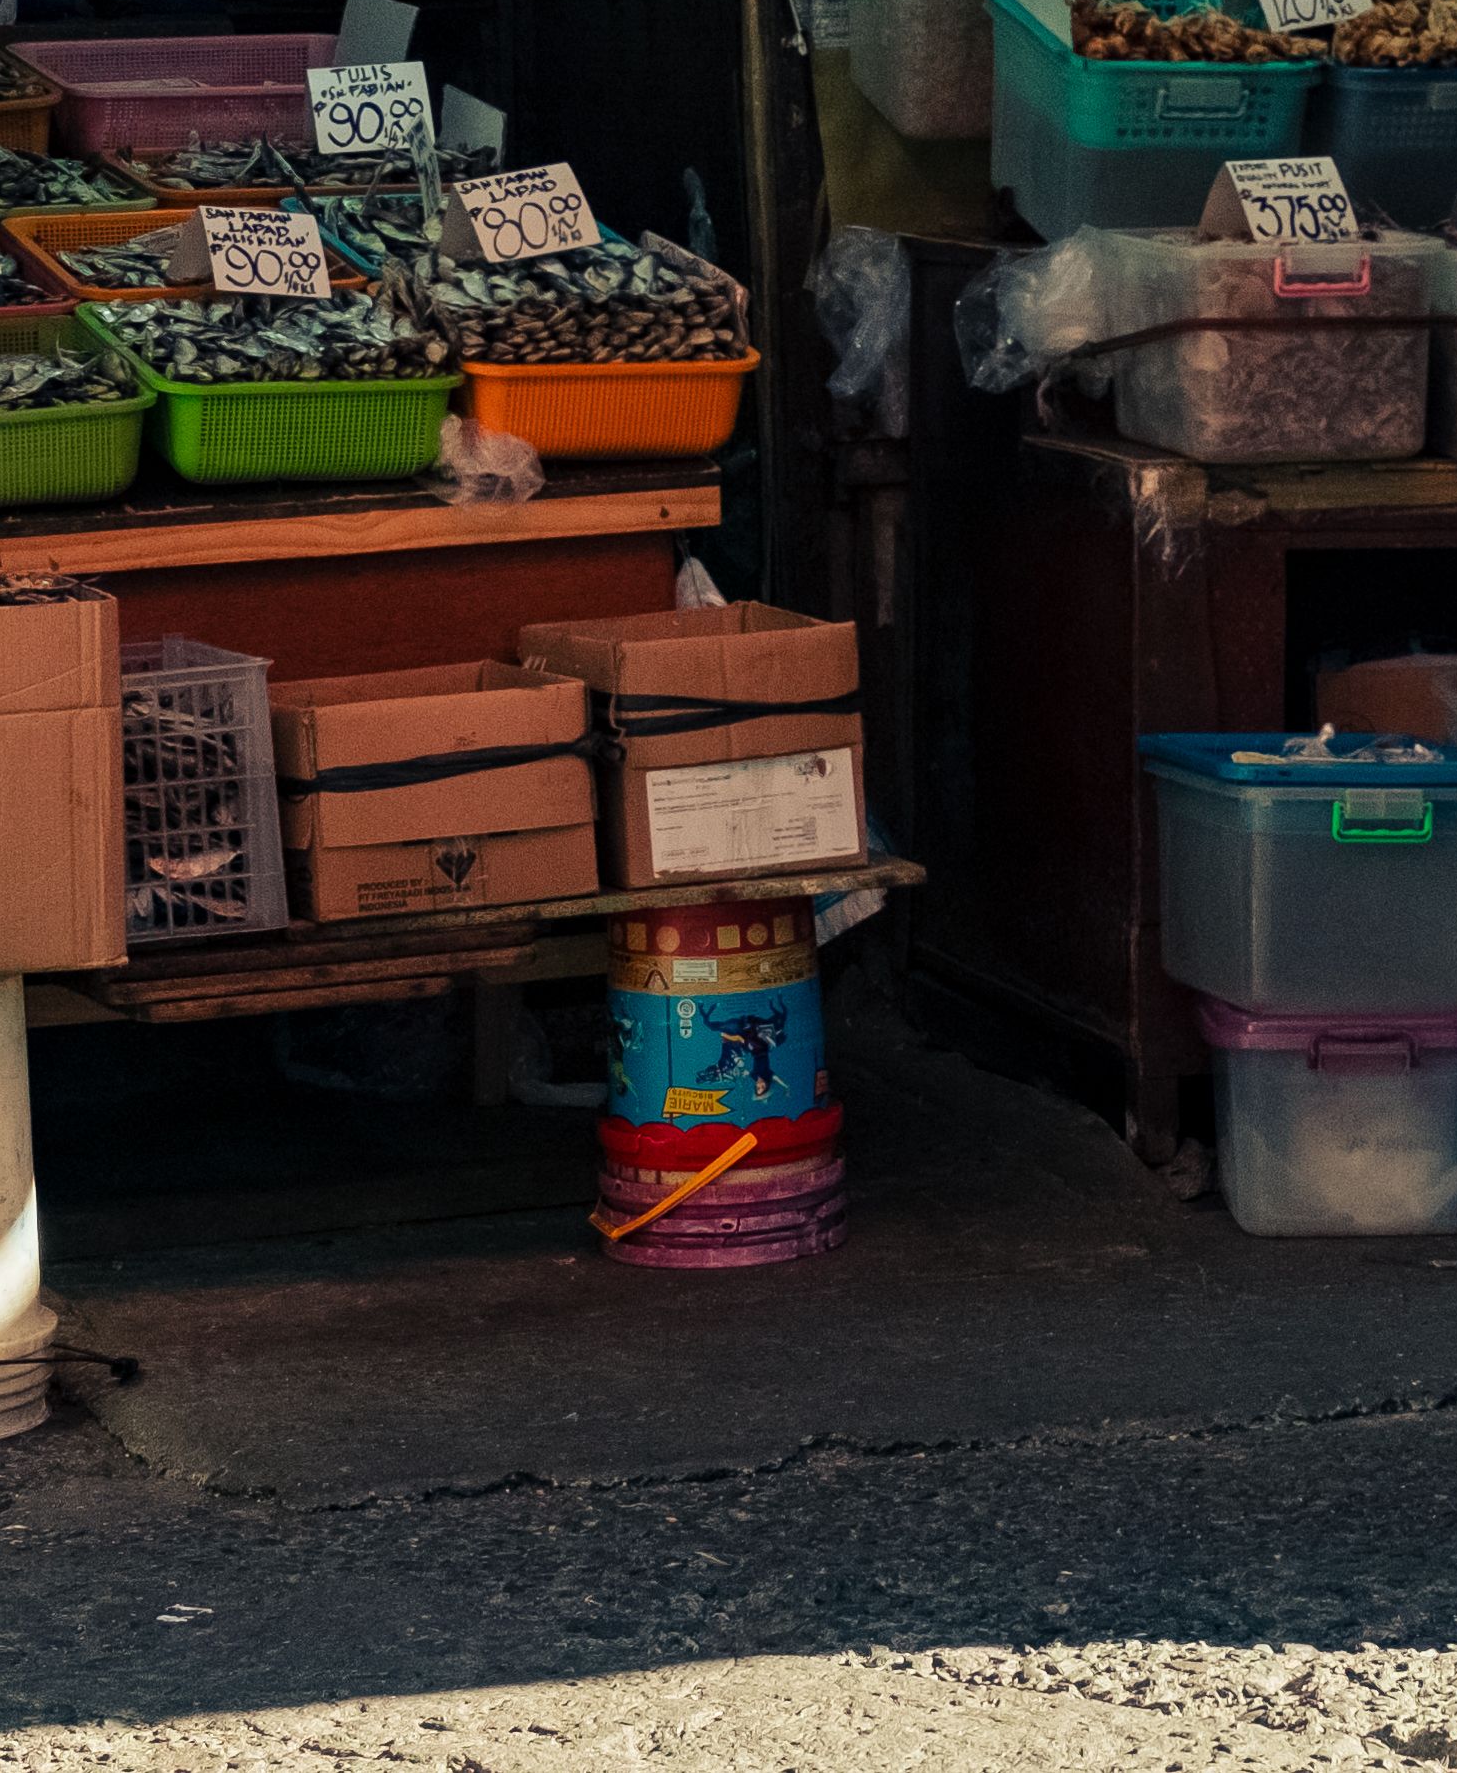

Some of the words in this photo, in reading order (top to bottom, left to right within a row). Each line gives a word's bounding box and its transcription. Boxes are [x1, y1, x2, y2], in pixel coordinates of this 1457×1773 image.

[330, 64, 392, 84] TULIS
[1278, 161, 1323, 178] PUSIT
[461, 179, 491, 195] SAN
[489, 179, 557, 204] LAPAD
[205, 207, 236, 220] SAN
[228, 221, 290, 237] LAPAD
[357, 880, 409, 893] PRODUCED
[358, 900, 408, 913] INDONESIA
[669, 1097, 715, 1112] MARIE
